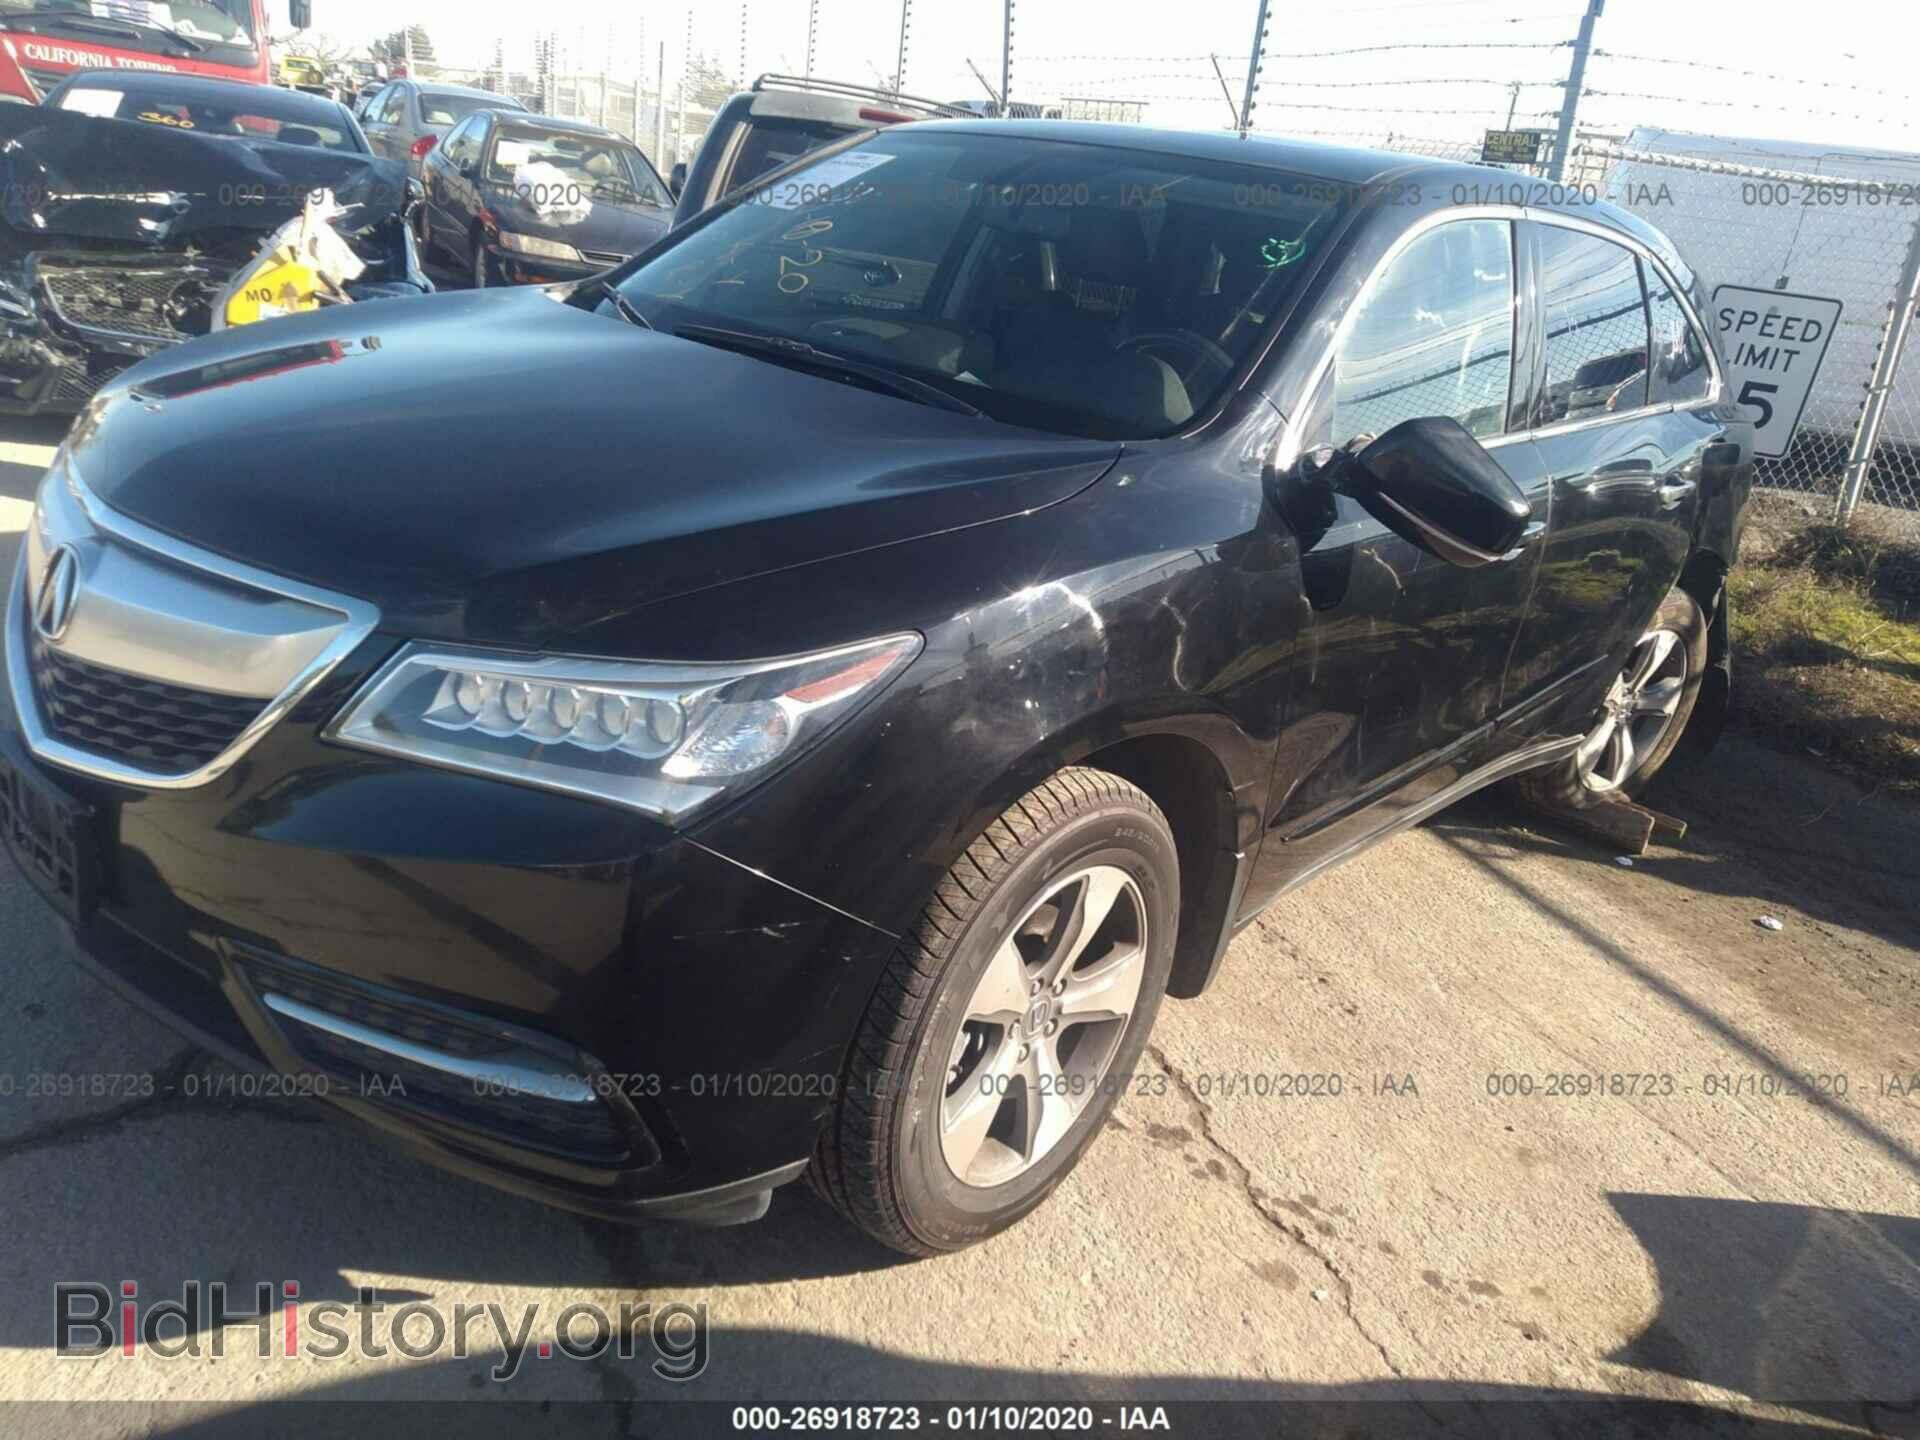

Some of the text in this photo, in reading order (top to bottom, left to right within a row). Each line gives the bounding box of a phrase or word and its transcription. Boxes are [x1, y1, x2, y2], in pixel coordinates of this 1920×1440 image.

[24, 43, 112, 67] CALIFORNIA
[138, 111, 194, 128] 360
[1487, 131, 1537, 147] CENTRAL
[1719, 307, 1823, 344] SPEED
[1727, 342, 1801, 373] IMIT
[1737, 380, 1779, 430] 5
